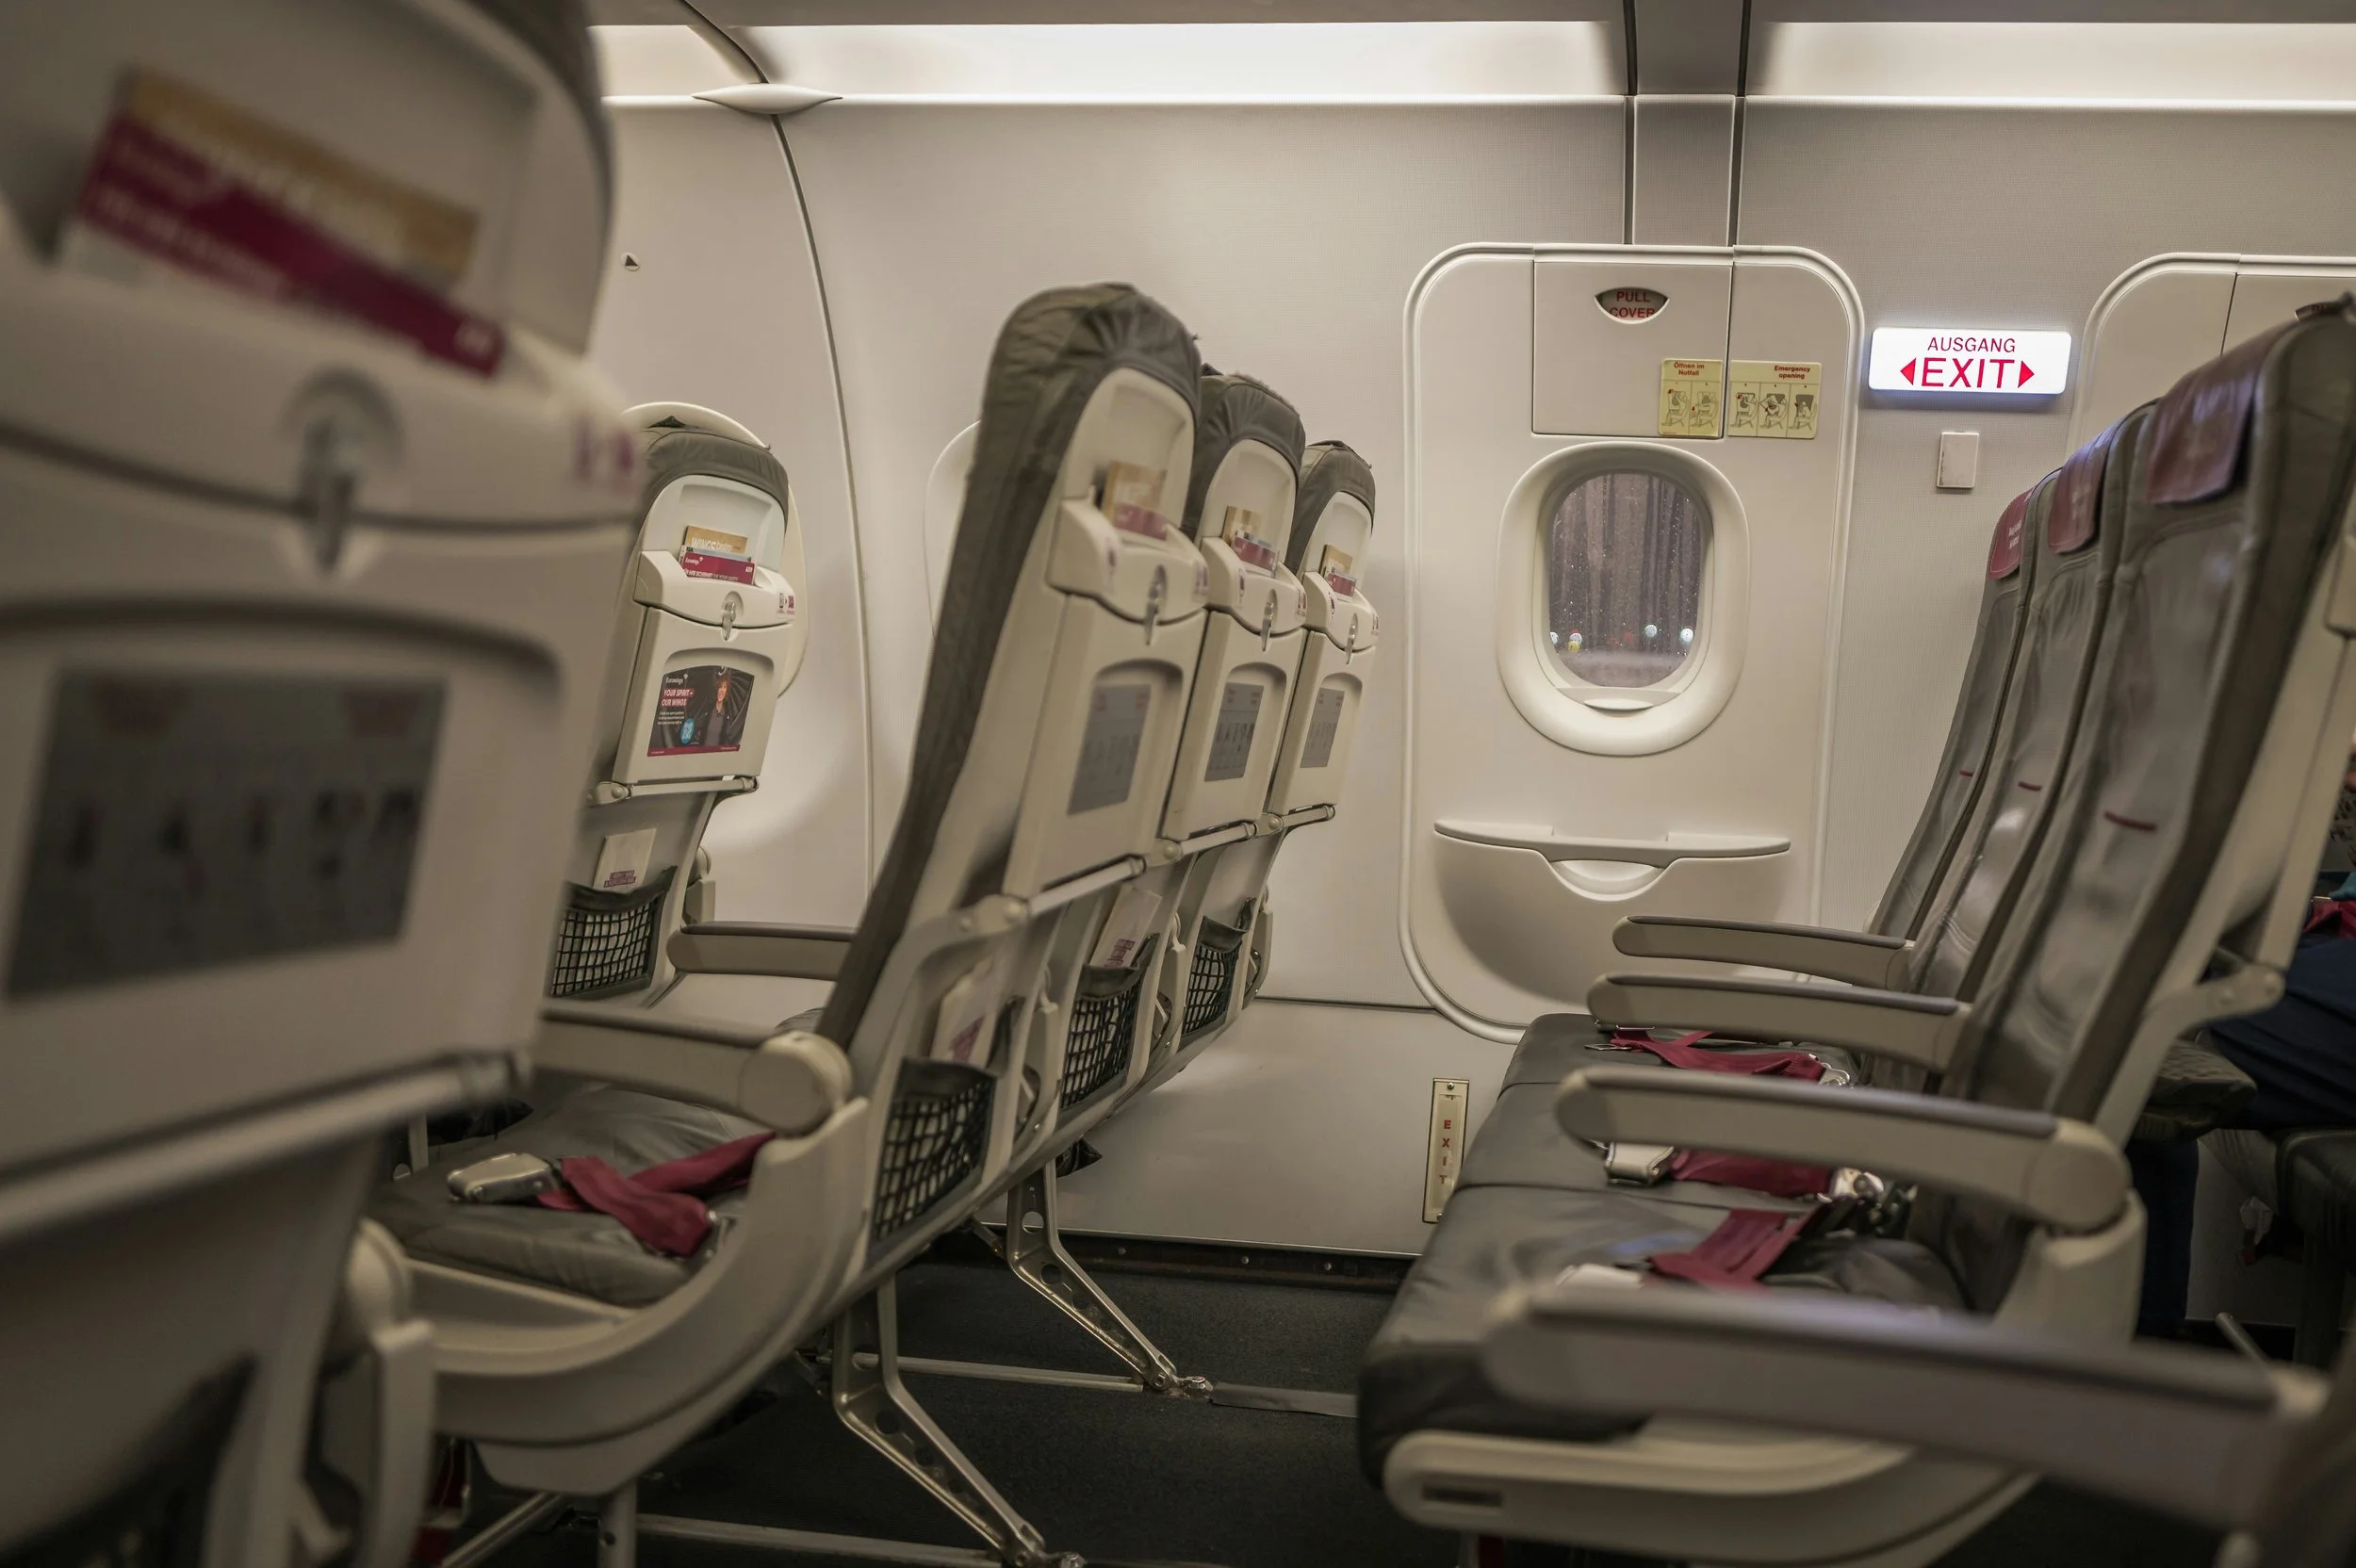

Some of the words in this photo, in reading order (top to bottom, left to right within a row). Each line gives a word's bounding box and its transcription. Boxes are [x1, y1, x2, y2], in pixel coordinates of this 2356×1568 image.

[1616, 290, 1650, 302] PULL
[1610, 307, 1656, 318] COVER
[1927, 336, 2016, 352] AUSGANG
[1921, 357, 2015, 388] EXIT
[665, 677, 683, 685] Eurowings
[1439, 1119, 1452, 1184] EXIT
